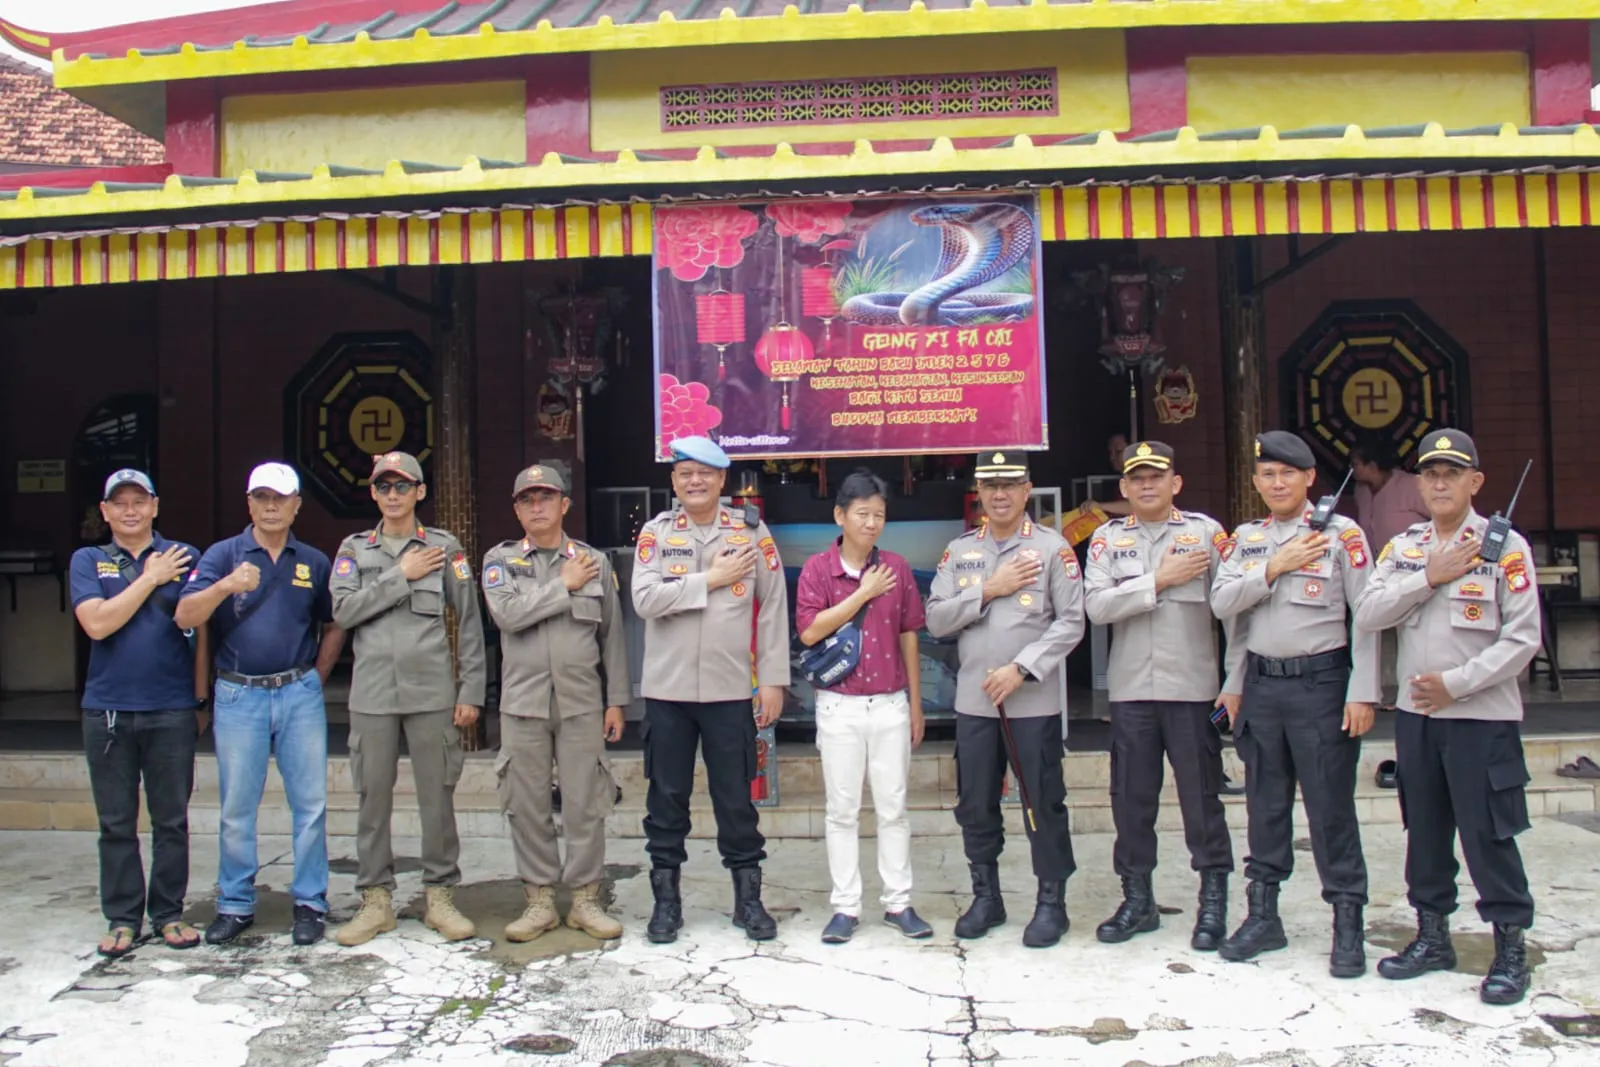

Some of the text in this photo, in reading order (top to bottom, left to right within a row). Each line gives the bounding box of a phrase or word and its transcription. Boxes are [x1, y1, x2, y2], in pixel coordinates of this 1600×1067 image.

[862, 328, 1014, 351] GONG XI FA CAI
[771, 358, 832, 375] SELAMAT
[833, 357, 878, 373] TAHUN
[879, 356, 913, 371] BARU
[915, 354, 954, 370] IMLEK
[831, 411, 885, 426] BUDDHA
[1113, 550, 1138, 560] EKO
[1241, 546, 1268, 558] DONNY
[955, 560, 986, 571] NICOLAS
